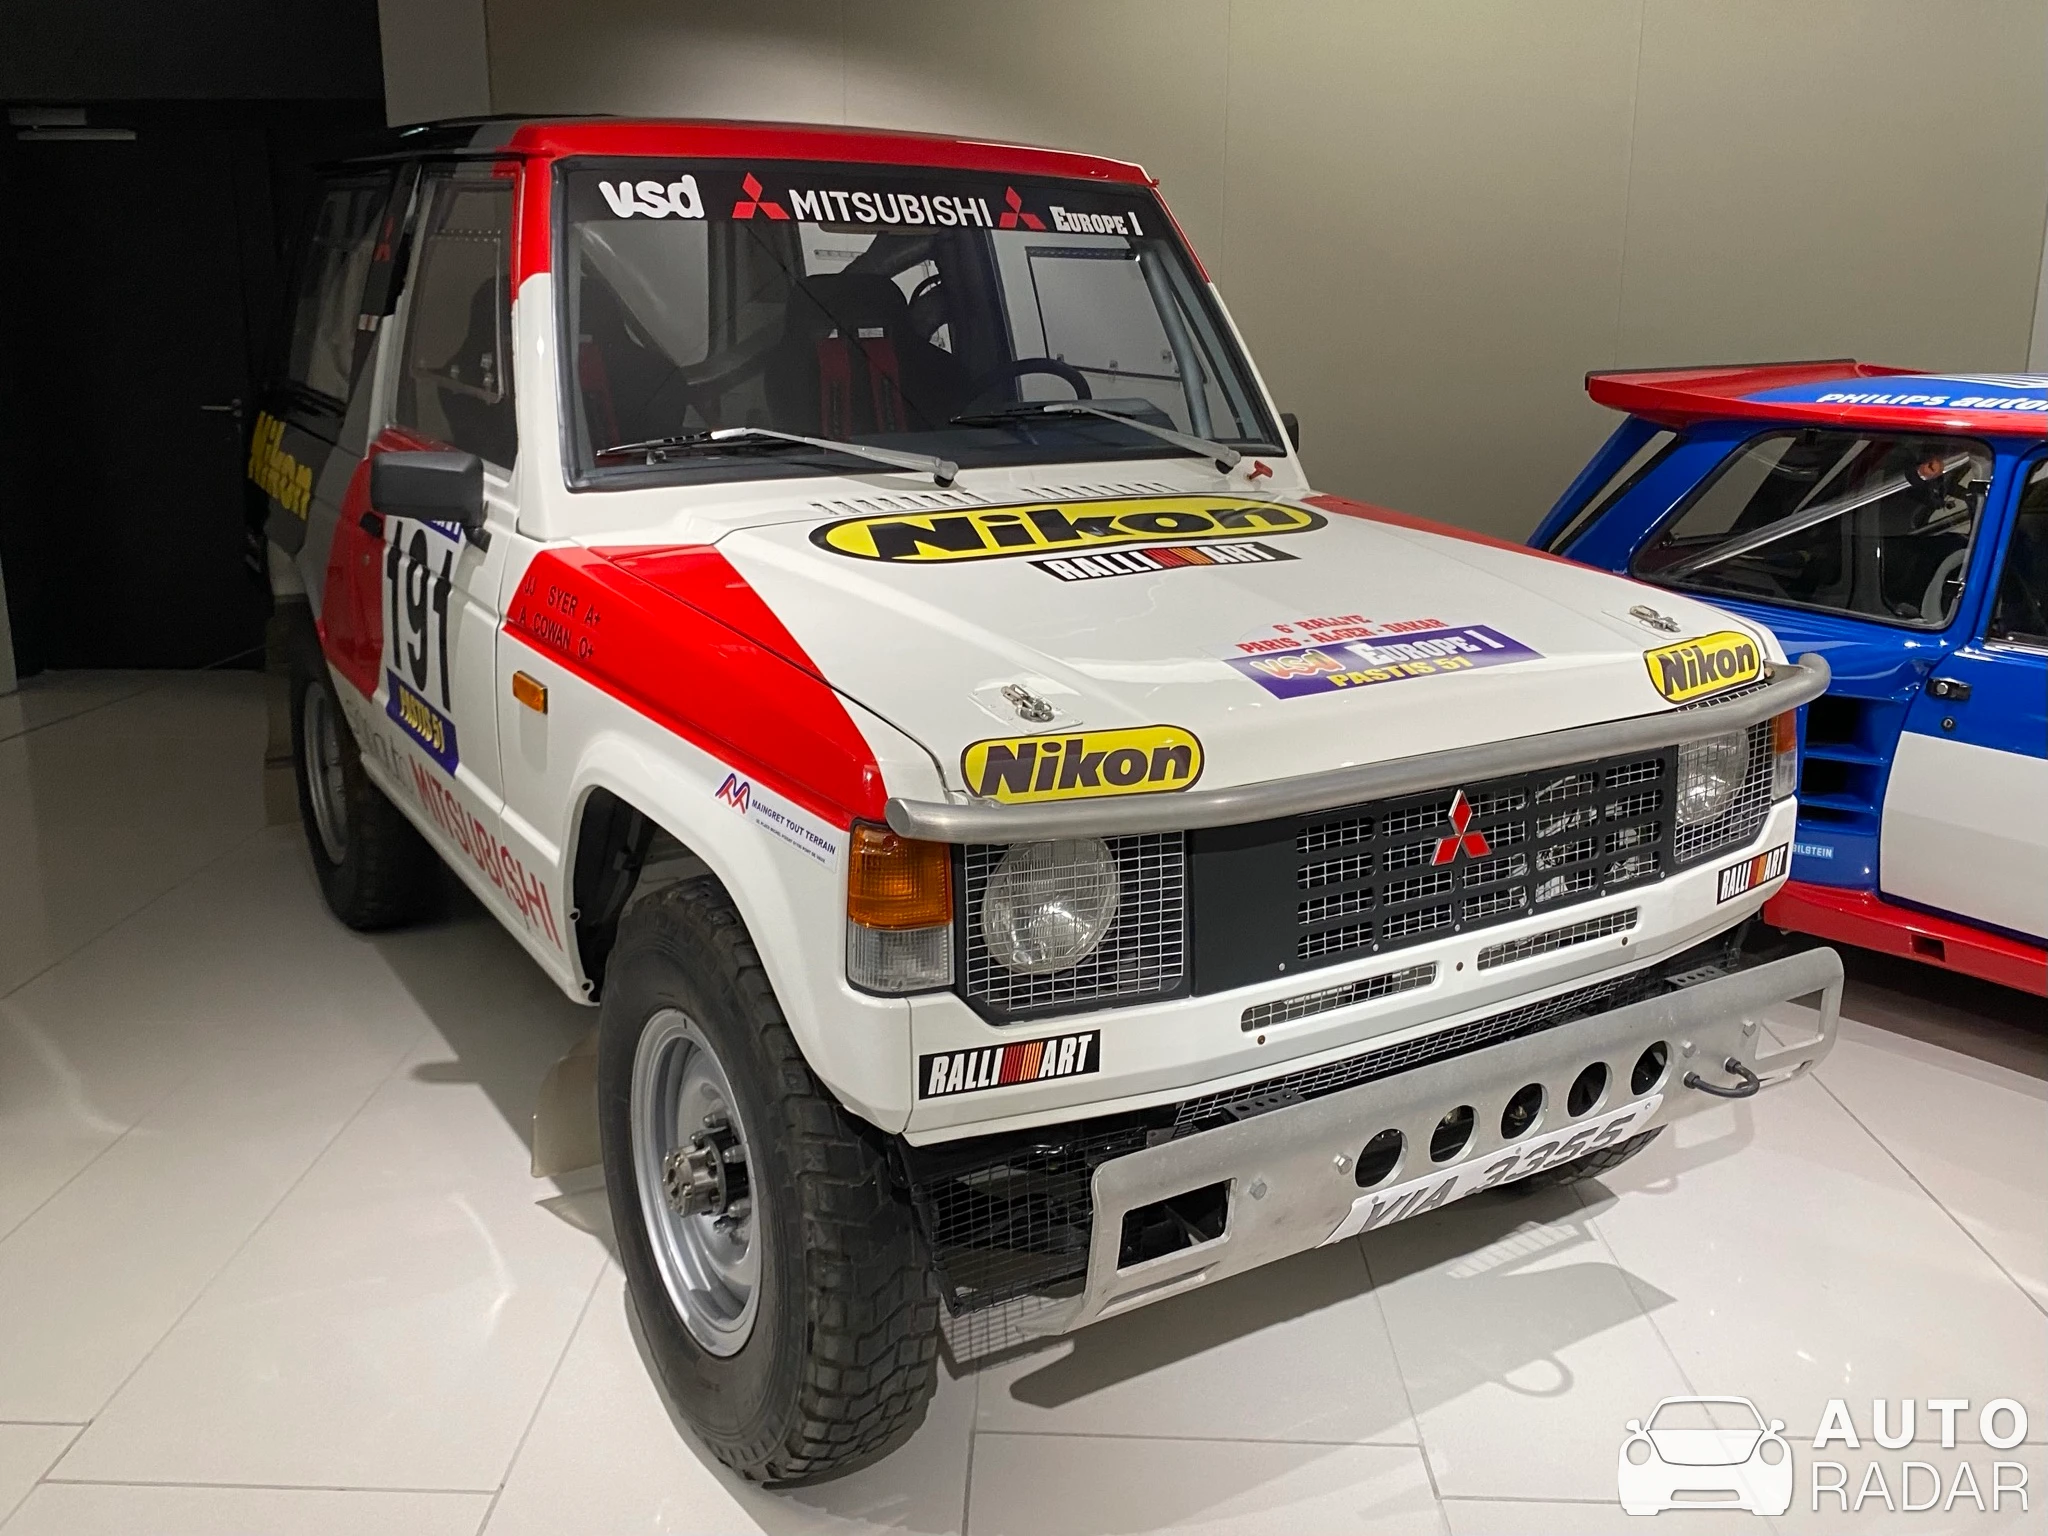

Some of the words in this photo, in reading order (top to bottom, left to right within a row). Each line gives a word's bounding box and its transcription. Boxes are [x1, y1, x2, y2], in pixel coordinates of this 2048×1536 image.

[598, 174, 705, 219] vsd
[788, 189, 993, 228] MITSUBISHI
[1816, 393, 1951, 406] PHILIPS
[867, 507, 1300, 559] Nikon
[387, 520, 454, 713] 191
[518, 606, 528, 628] A
[533, 611, 572, 651] COWAN
[547, 585, 578, 618] SYER
[584, 604, 601, 627] A+
[1293, 614, 1373, 631] RALLYE
[1234, 637, 1302, 654] PARIS
[1309, 626, 1378, 644] ALGER
[1380, 618, 1450, 636] DAKAR
[1326, 661, 1434, 687] PASTIS
[1435, 656, 1475, 669] 51
[1656, 643, 1756, 696] Nikon
[979, 739, 1192, 796] Nikon
[752, 799, 785, 825] MAINGRET
[786, 819, 804, 836] TOUT
[805, 830, 836, 855] TERRAIN
[408, 752, 564, 952] MITSUBISHI
[1793, 844, 1833, 858] BILSTEIN
[1359, 1175, 1460, 1235] VIA
[1464, 1112, 1637, 1195] 3355
